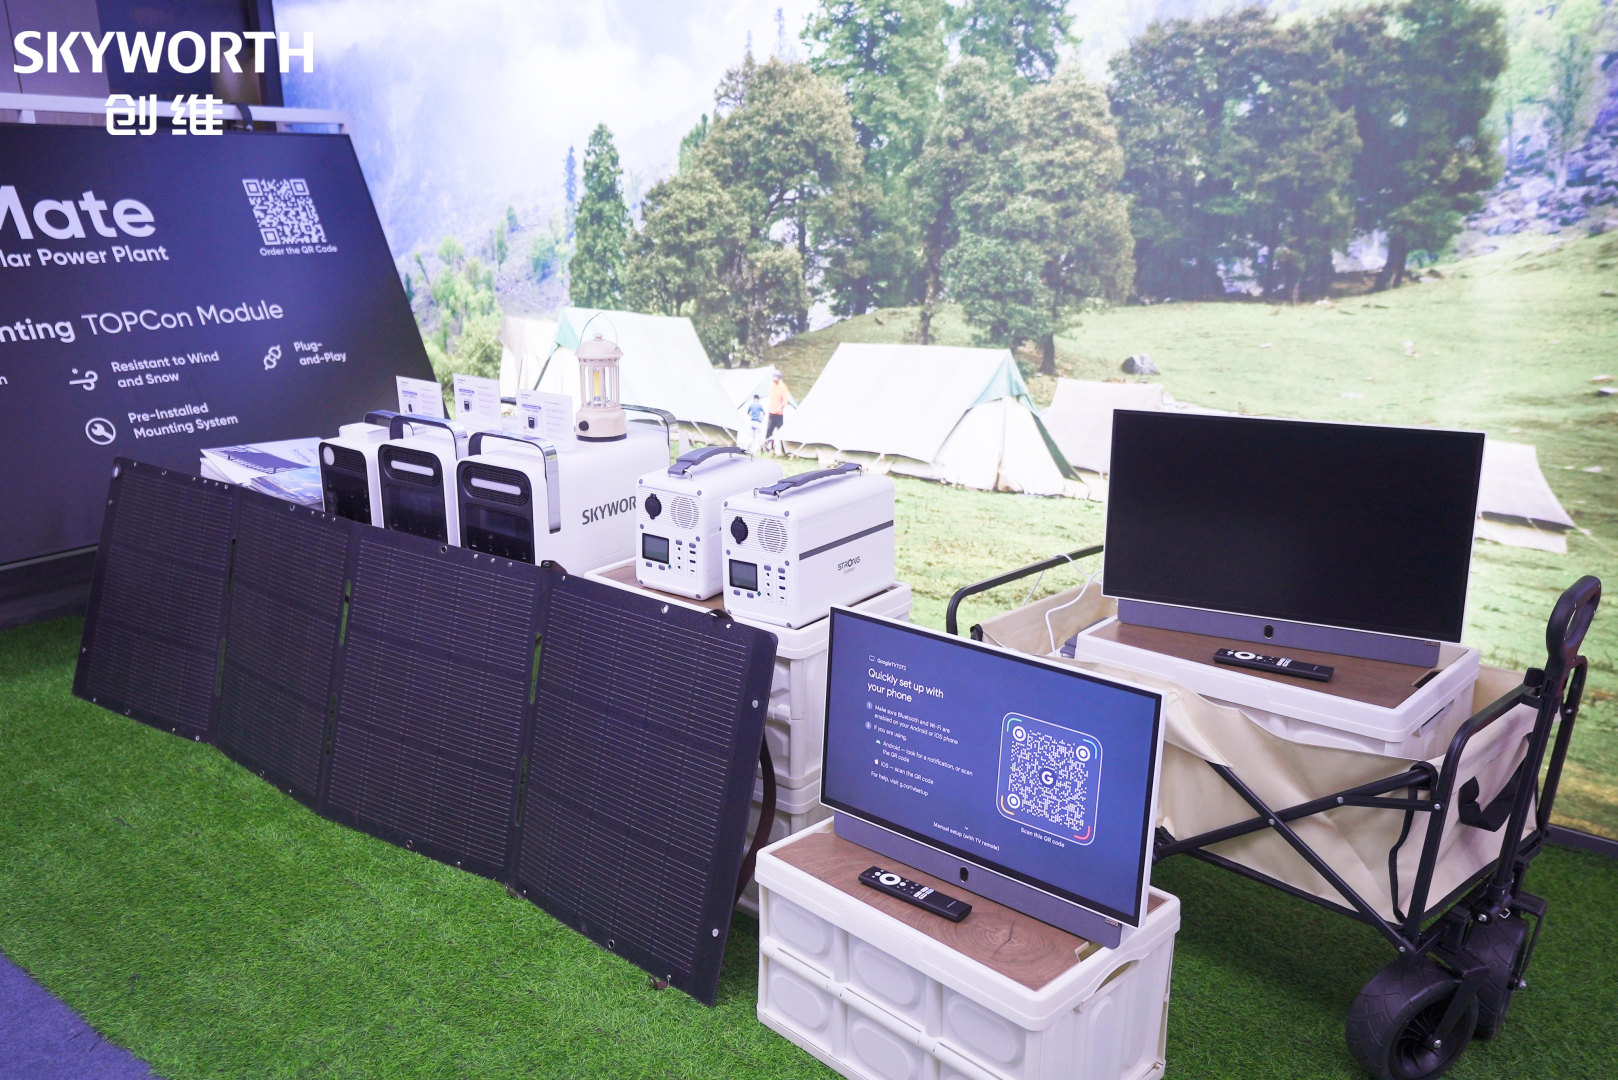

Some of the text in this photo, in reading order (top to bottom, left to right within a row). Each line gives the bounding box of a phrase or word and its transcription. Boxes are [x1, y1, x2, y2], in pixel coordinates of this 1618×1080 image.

[37, 248, 107, 266] Power
[111, 244, 169, 263] Plant
[259, 245, 338, 256] Order the QR Code
[0, 299, 284, 343] nting TOPCon Module
[293, 341, 323, 353] Plug-
[111, 351, 220, 373] Resistant to Wind
[299, 351, 347, 366] and-Play
[117, 372, 180, 388] and Snow
[127, 402, 209, 424] Pre-Installed
[133, 415, 239, 439] Mounting System
[582, 496, 636, 525] SKYWOR
[837, 556, 861, 571] STRONG
[867, 681, 912, 703] your phone
[868, 668, 944, 699] Quickly set up with
[874, 704, 887, 713] Make
[887, 709, 897, 717] sure
[898, 711, 919, 724] Bluetooth
[920, 719, 929, 727] and
[942, 726, 951, 734] are
[874, 713, 892, 723] enabled
[899, 721, 909, 729] your
[909, 724, 928, 735] Android
[934, 731, 942, 740] iOS
[943, 735, 958, 745] phone
[882, 749, 890, 757] the
[898, 755, 910, 763] code
[883, 741, 900, 751] Android
[961, 768, 973, 776] scan
[870, 770, 878, 778] For
[889, 777, 899, 786] visit
[880, 761, 888, 769] iOS
[895, 767, 905, 775] scan
[914, 773, 922, 781] QR
[922, 776, 934, 785] code
[1041, 770, 1054, 785] G
[933, 822, 950, 832] Manual
[950, 828, 963, 838] setup
[963, 832, 974, 842] (with
[982, 841, 1000, 852] remote)
[1020, 827, 1065, 848] Scan this QR code
